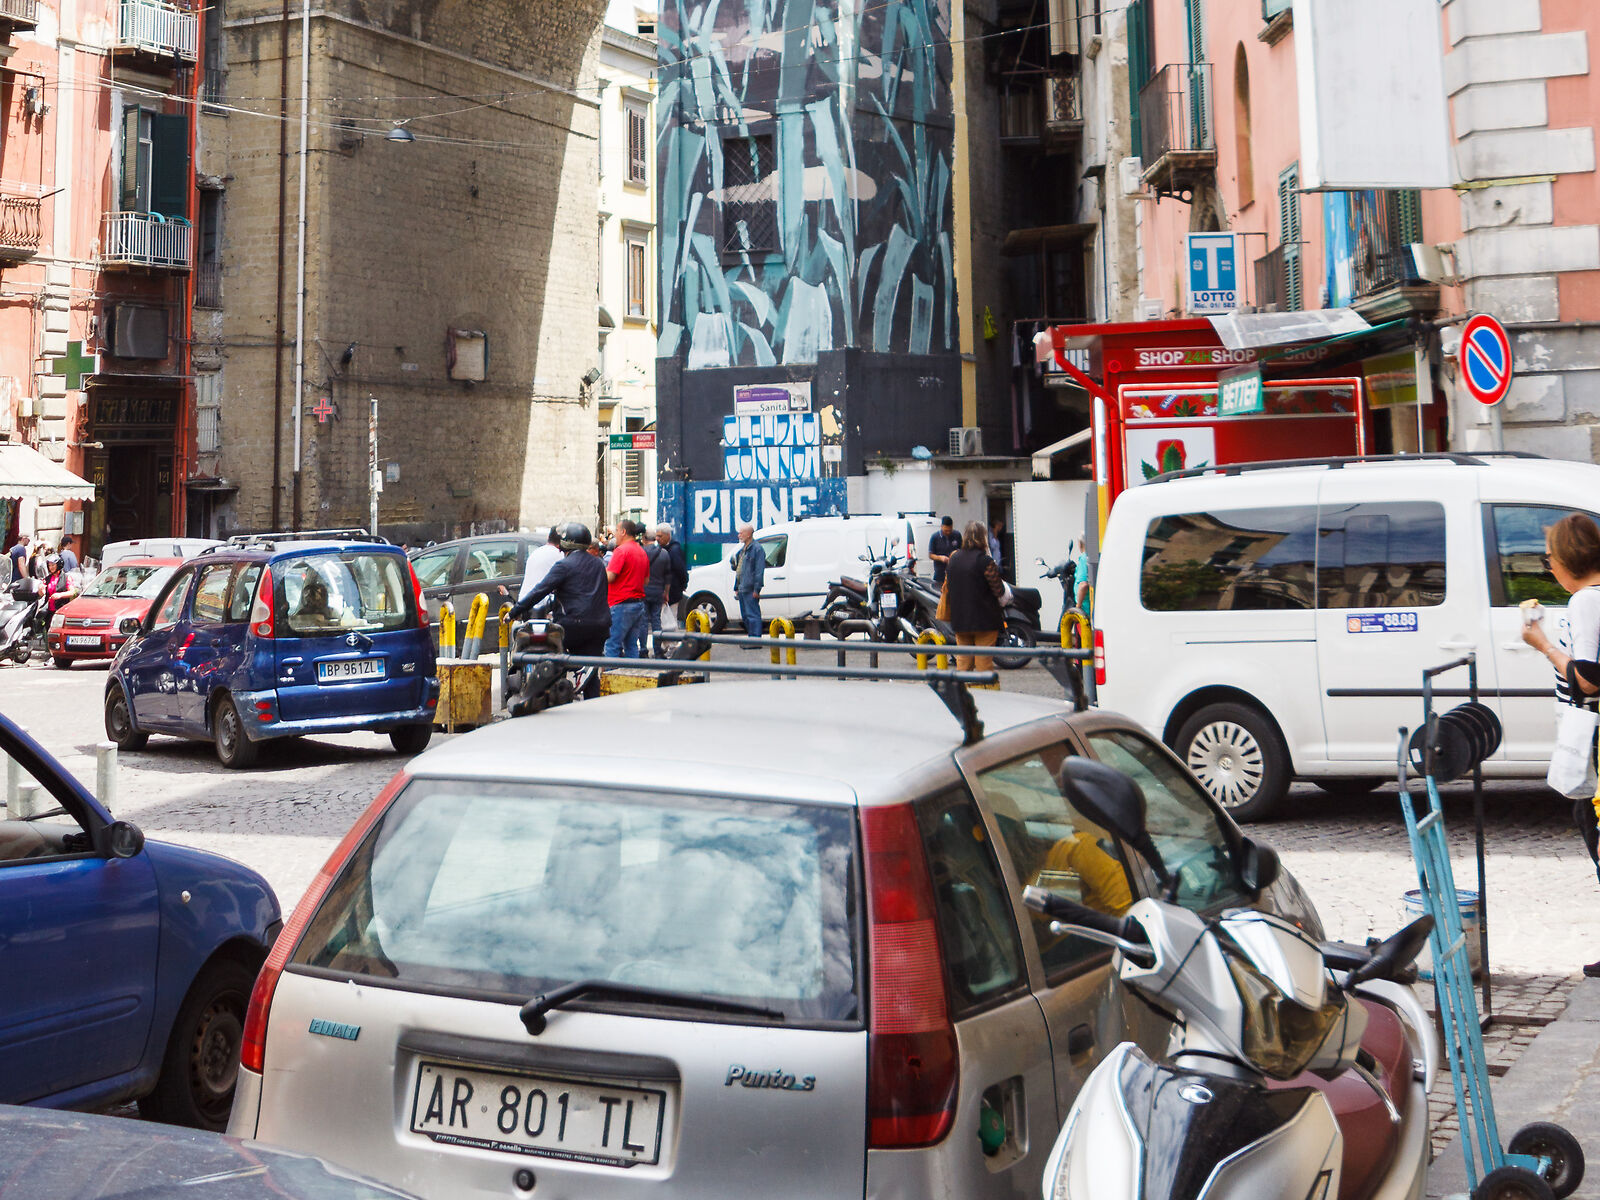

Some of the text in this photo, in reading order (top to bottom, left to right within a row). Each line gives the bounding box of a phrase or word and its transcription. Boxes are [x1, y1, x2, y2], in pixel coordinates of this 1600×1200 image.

[1194, 291, 1235, 302] LOTTO
[1139, 351, 1184, 366] SHOP
[1211, 350, 1256, 363] SHOP
[1222, 376, 1258, 410] BETTER
[327, 663, 340, 677] BP
[311, 1019, 358, 1039] FIAT
[725, 1064, 796, 1091] Punto
[424, 1074, 645, 1152] AR 801 TL
